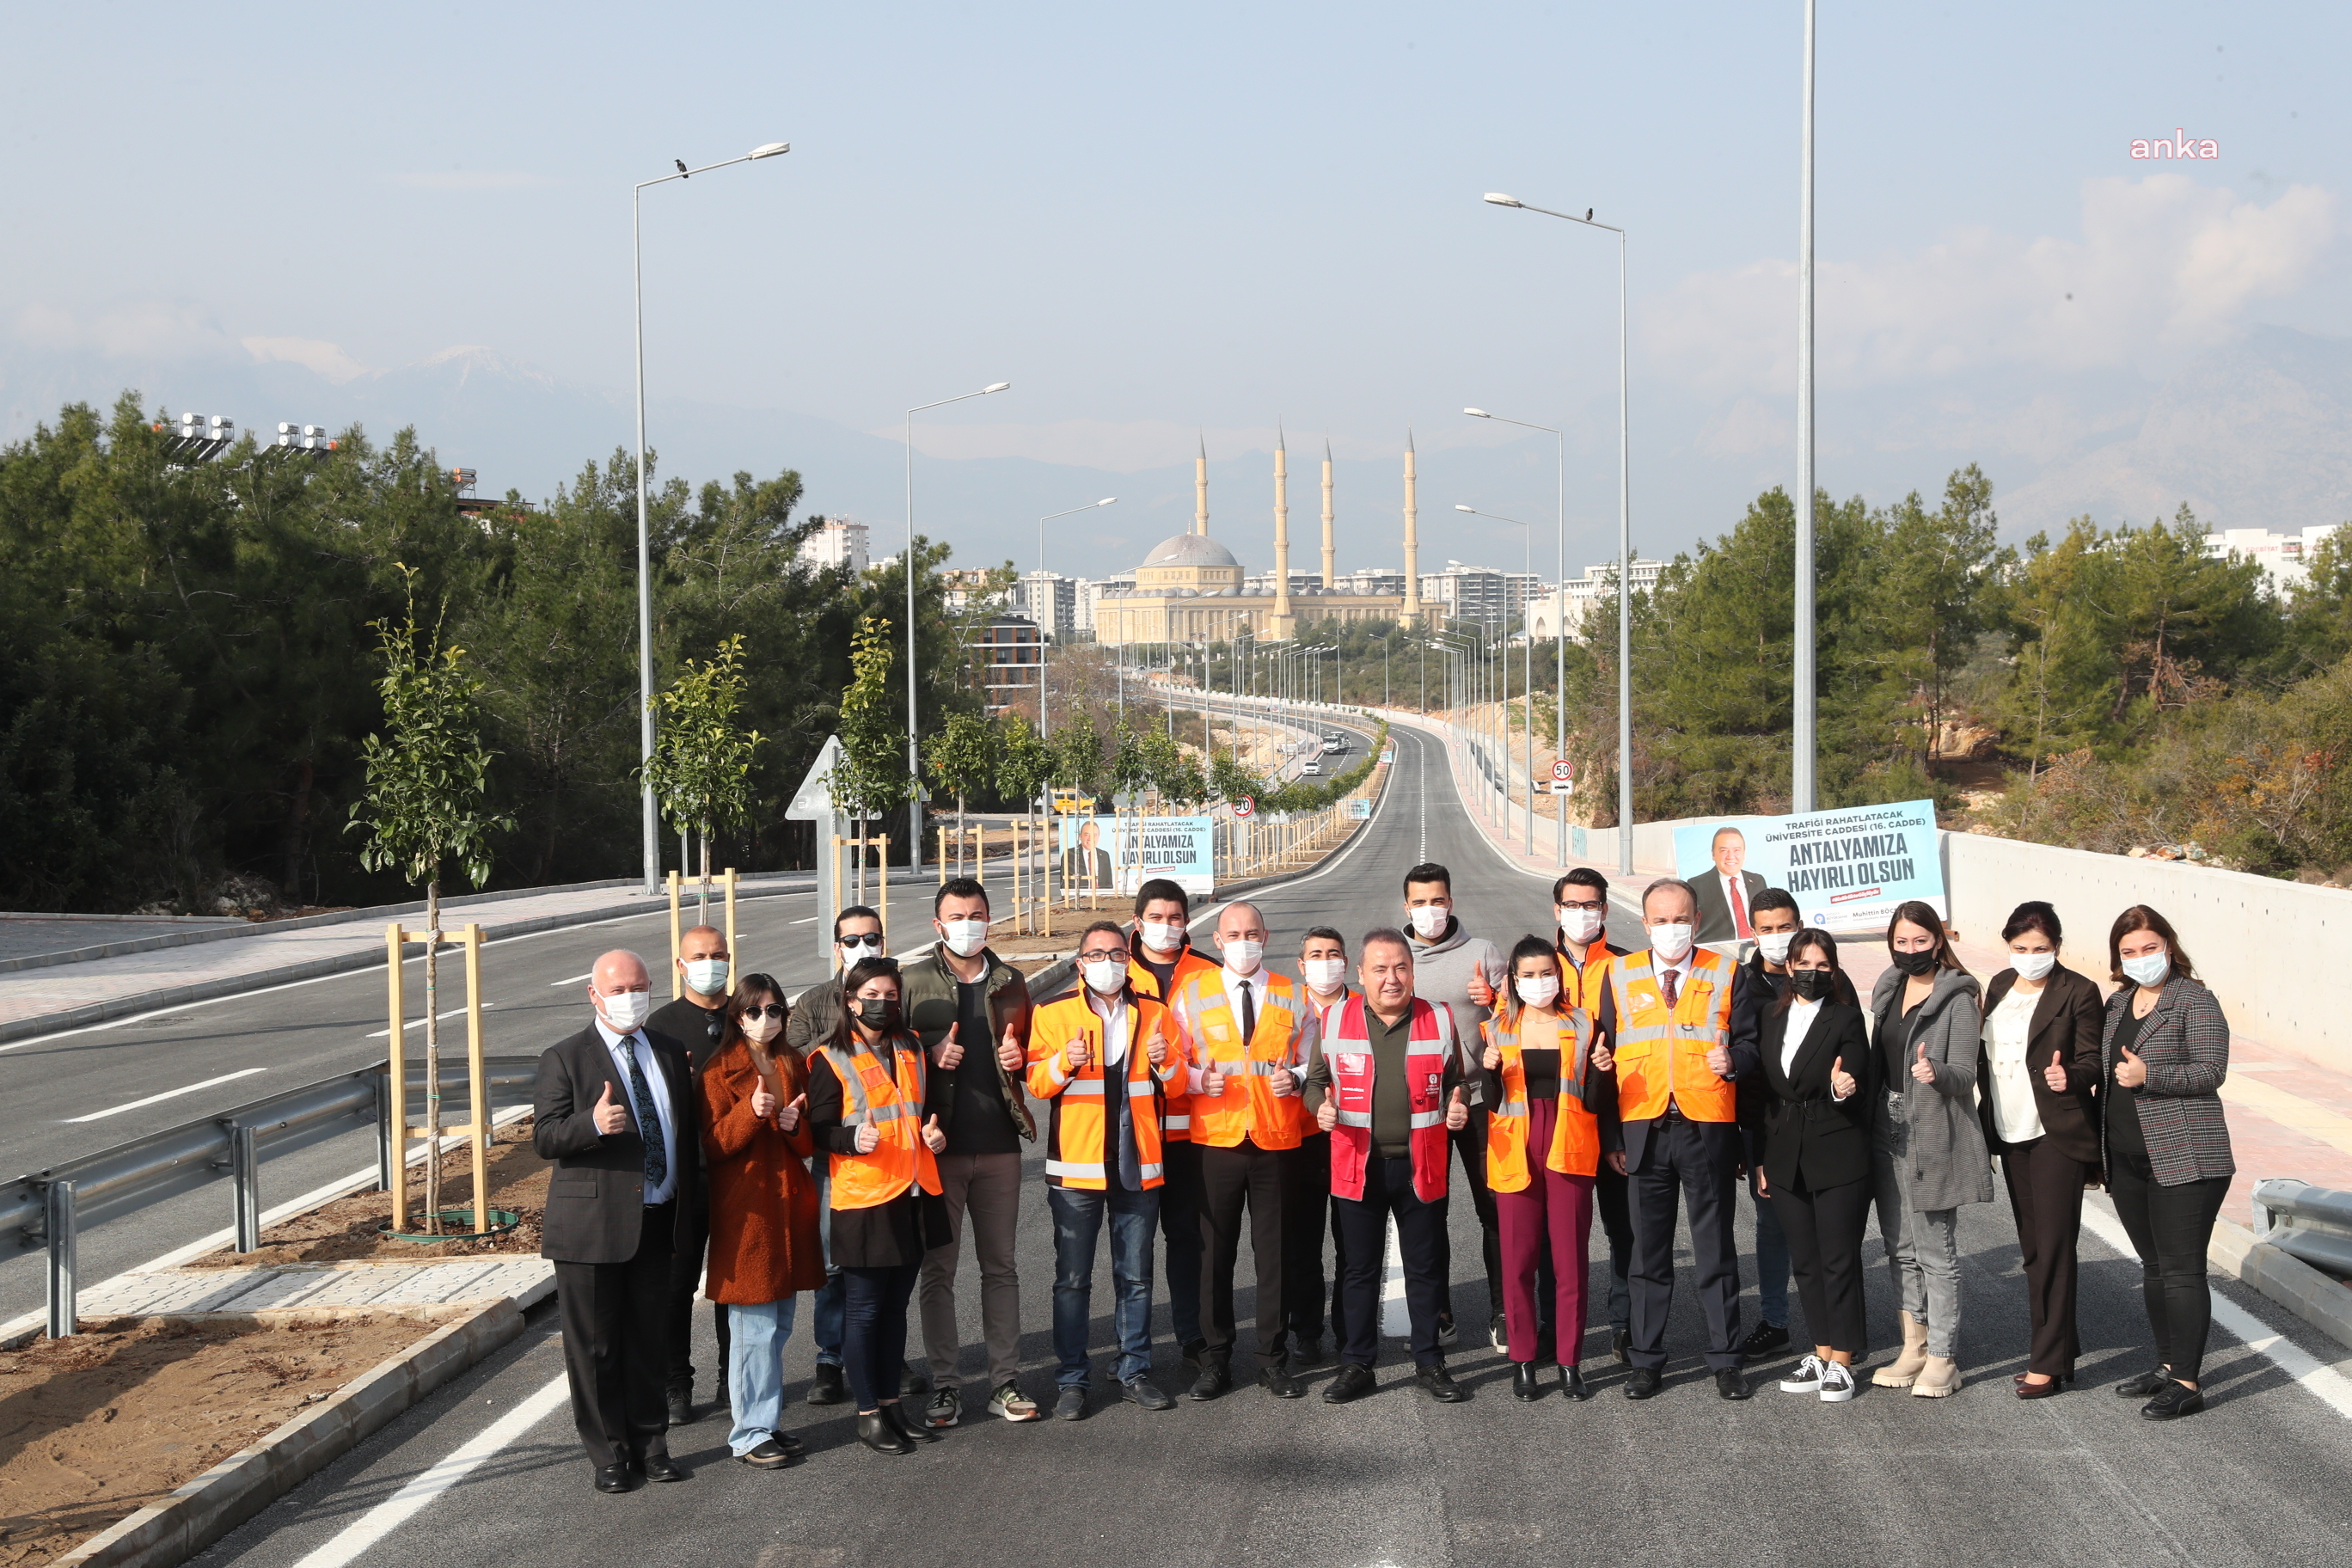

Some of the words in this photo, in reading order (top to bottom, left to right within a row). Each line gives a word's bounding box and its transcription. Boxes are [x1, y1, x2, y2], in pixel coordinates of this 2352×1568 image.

[1556, 765, 1569, 775] 50
[1766, 829, 1823, 842] ÜNİVERSİTE
[1825, 824, 1868, 836] CADDESİ
[1869, 822, 1887, 832] (16.
[1888, 818, 1926, 829] CADDE)
[1785, 818, 1823, 830] TRAFİĞİ
[1825, 811, 1904, 826] RAHATLATACAK
[1163, 850, 1197, 864] OLSUN
[1790, 832, 1908, 867] ANTALYAMIZA
[1787, 864, 1854, 893] HAYIRLI
[1857, 858, 1915, 885] OLSUN
